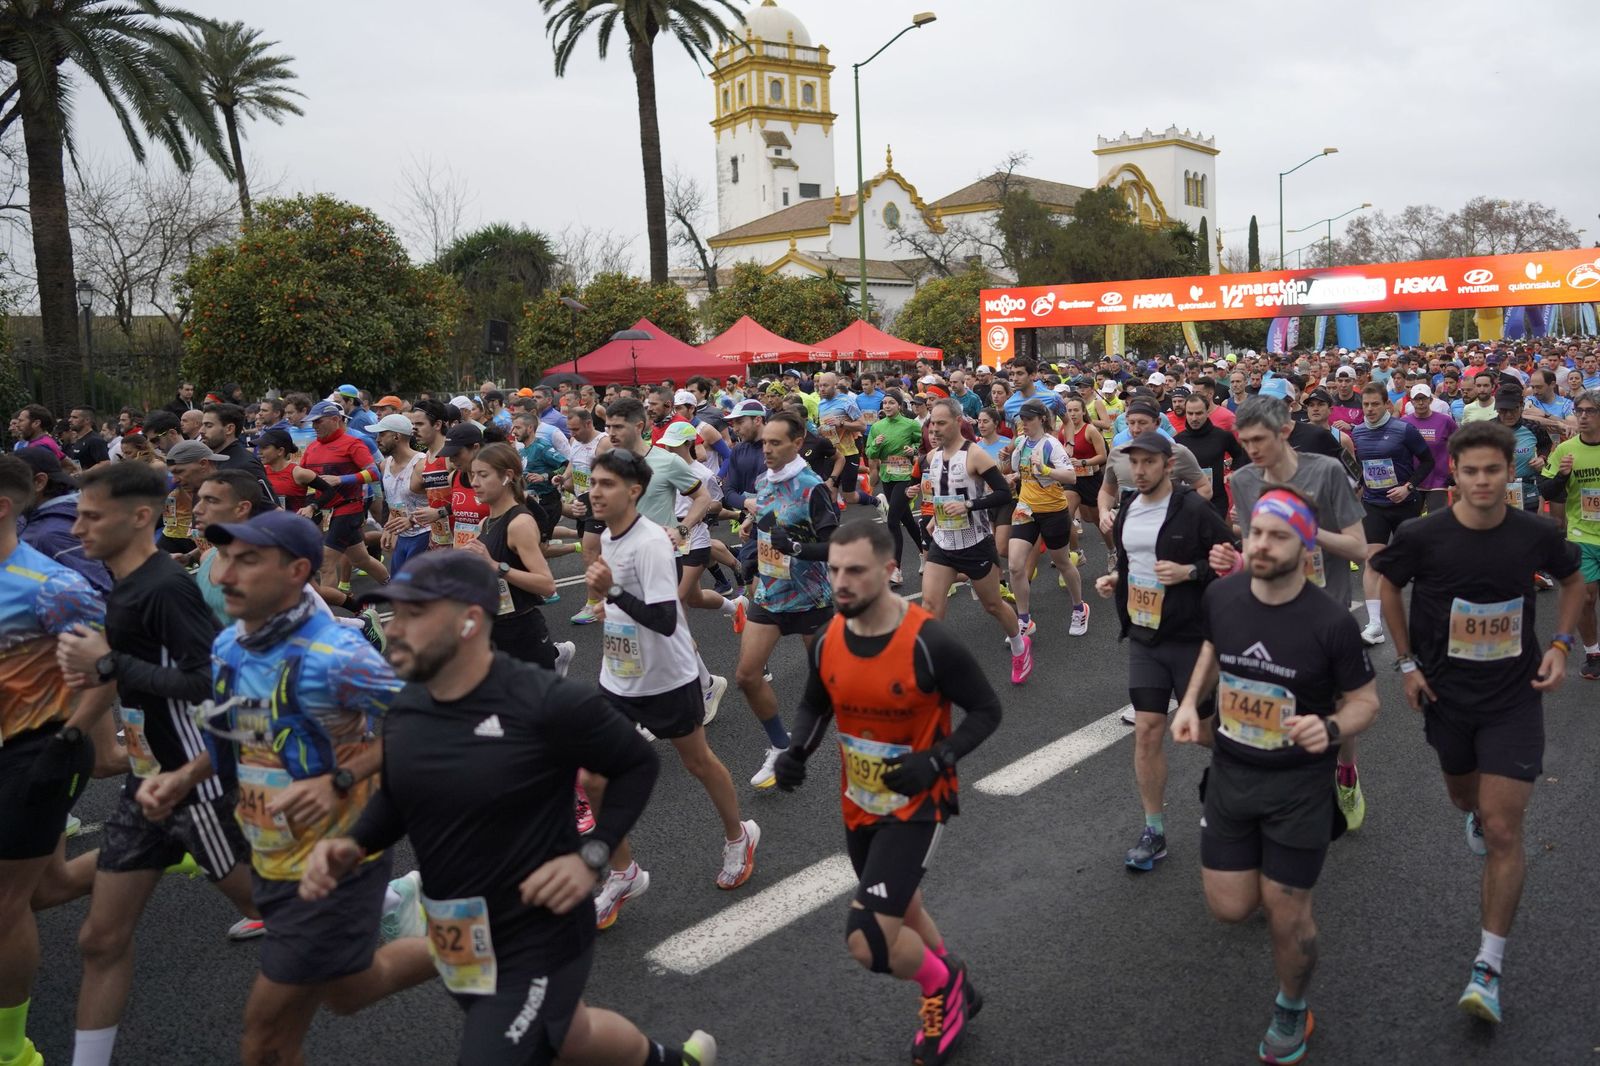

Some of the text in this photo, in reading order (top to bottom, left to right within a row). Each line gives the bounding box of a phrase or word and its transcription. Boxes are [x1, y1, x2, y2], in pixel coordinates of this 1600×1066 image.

[1393, 275, 1448, 294] HOKA
[1457, 284, 1499, 294] HYUNDAI
[1132, 293, 1175, 309] HOKA
[1367, 467, 1386, 476] 2726
[1465, 616, 1510, 636] 8150
[1237, 656, 1260, 669] YOUR
[1261, 661, 1297, 679] EVEREST
[1229, 691, 1274, 719] 7447
